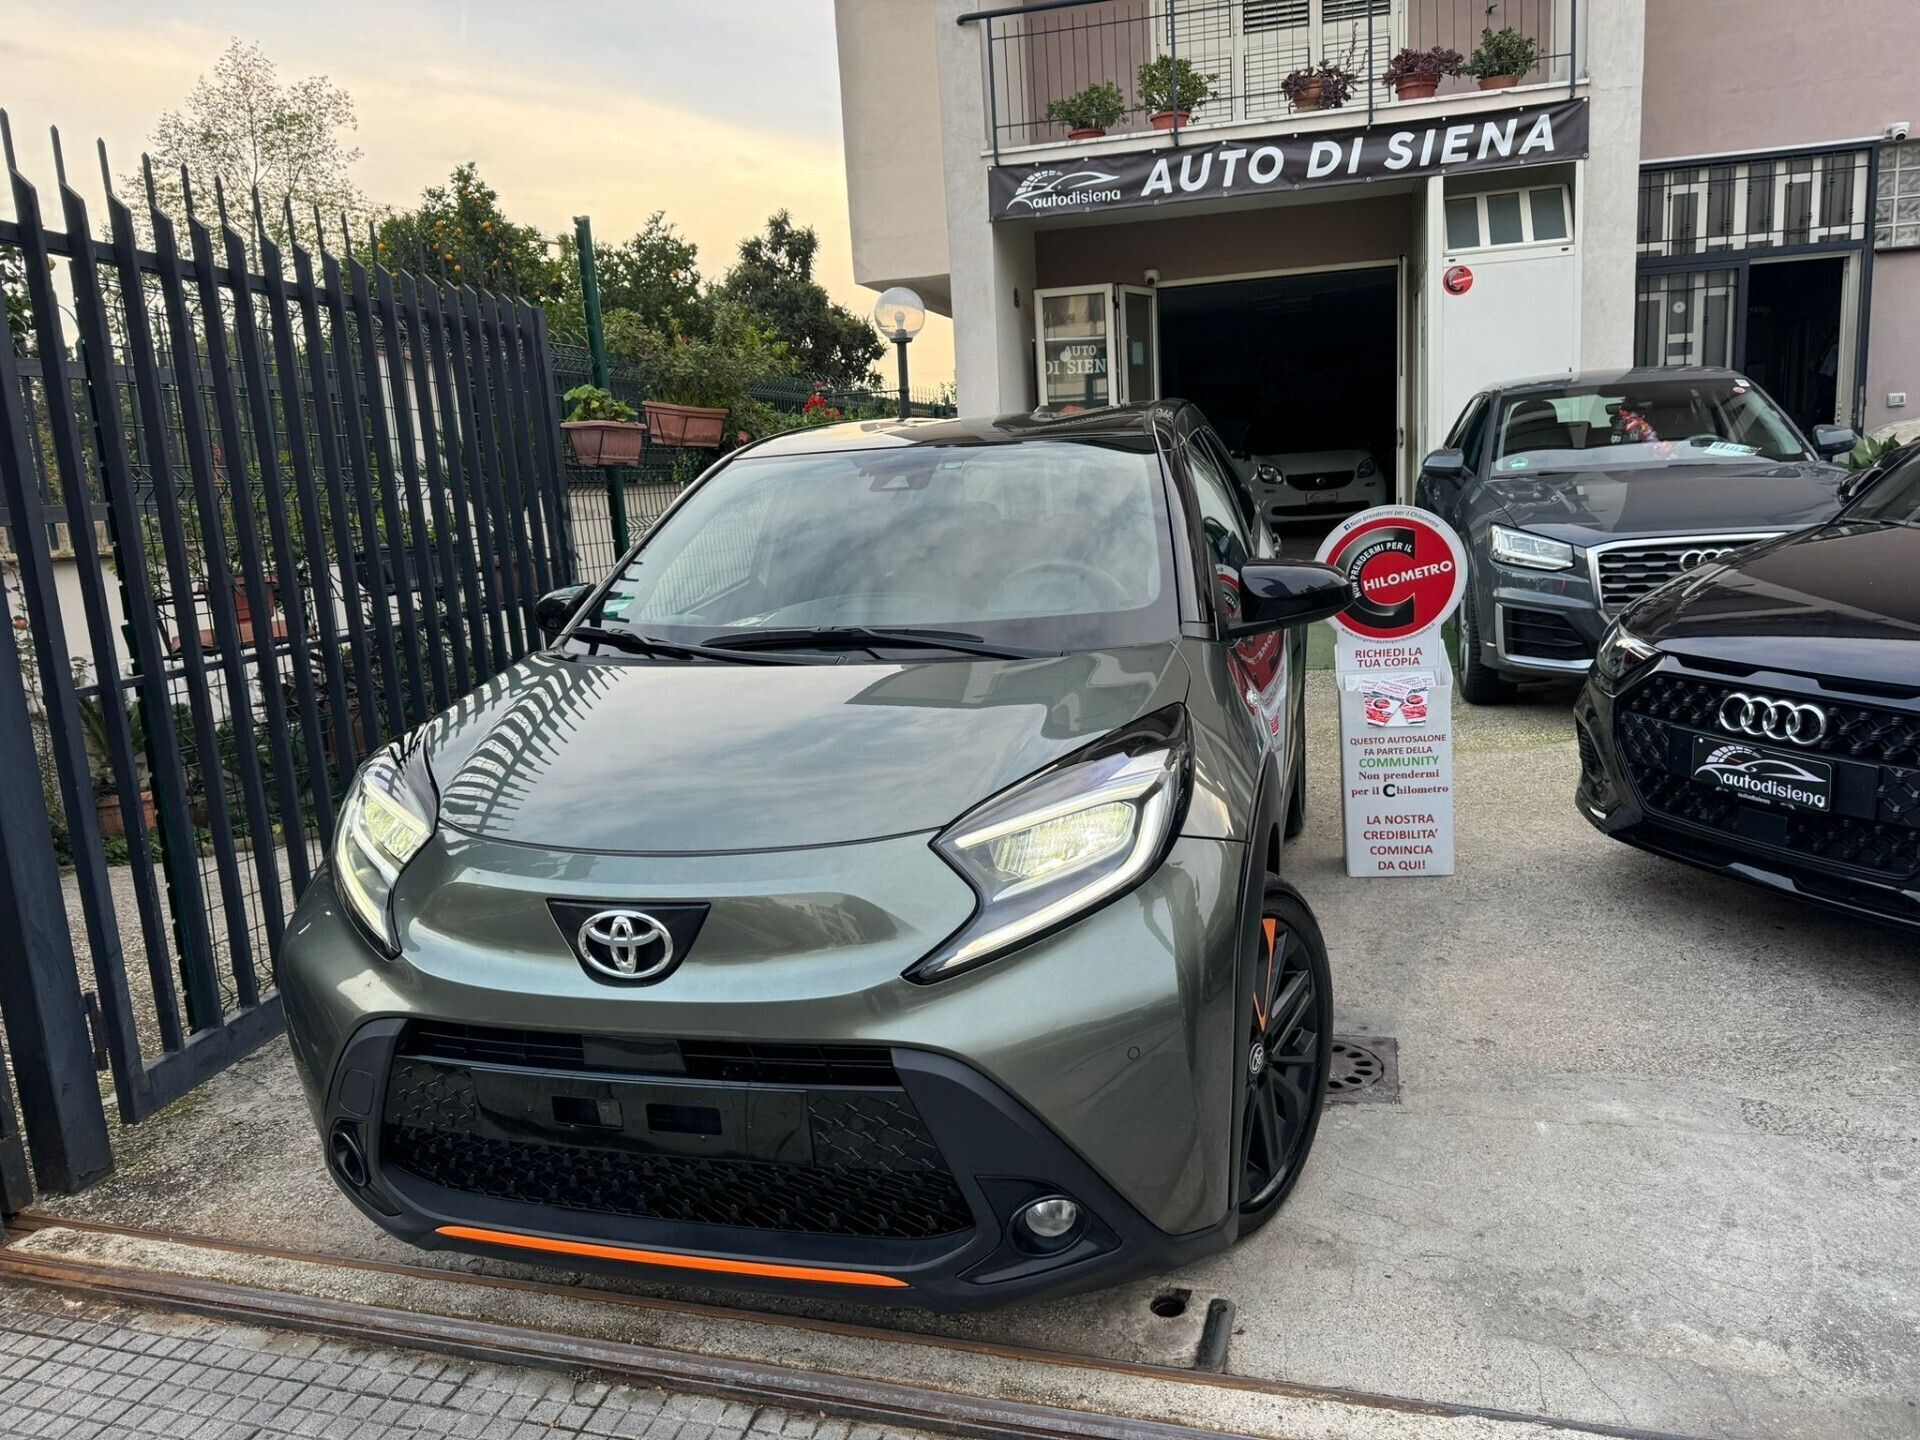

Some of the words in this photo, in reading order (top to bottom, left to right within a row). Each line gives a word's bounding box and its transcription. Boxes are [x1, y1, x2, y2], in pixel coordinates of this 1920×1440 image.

[1140, 146, 1284, 197] AUTO
[1306, 137, 1363, 179] DI
[1383, 113, 1555, 171] SIENA
[1033, 189, 1121, 209] autodisiena
[1063, 345, 1097, 357] AUTO
[1067, 358, 1107, 375] SIEN
[1350, 544, 1384, 580] PRENDERMI
[1386, 541, 1403, 551] PER
[1404, 543, 1412, 553] IL
[1355, 648, 1405, 659] RICHIEDI
[1408, 647, 1423, 656] LA
[1357, 659, 1381, 668] TUA
[1384, 657, 1420, 667] COPIA
[1350, 737, 1385, 746] QUESTO
[1387, 734, 1446, 744] AUTOSALONE
[1364, 748, 1374, 756] FA
[1377, 747, 1404, 756] PARTE
[1406, 746, 1433, 755] DELLA
[1359, 756, 1440, 768] COMMUNITY
[1358, 771, 1380, 781] Non
[1383, 769, 1440, 783] prendermi
[1351, 787, 1369, 798] per
[1372, 786, 1380, 796] il
[1383, 784, 1449, 798] Chilometro
[1723, 773, 1826, 808] autodisiena
[1366, 815, 1381, 825] LA
[1384, 814, 1435, 825] NOSTRA
[1370, 845, 1433, 855] COMINCIA
[1378, 861, 1395, 871] DA
[1398, 860, 1426, 872] QUI!
